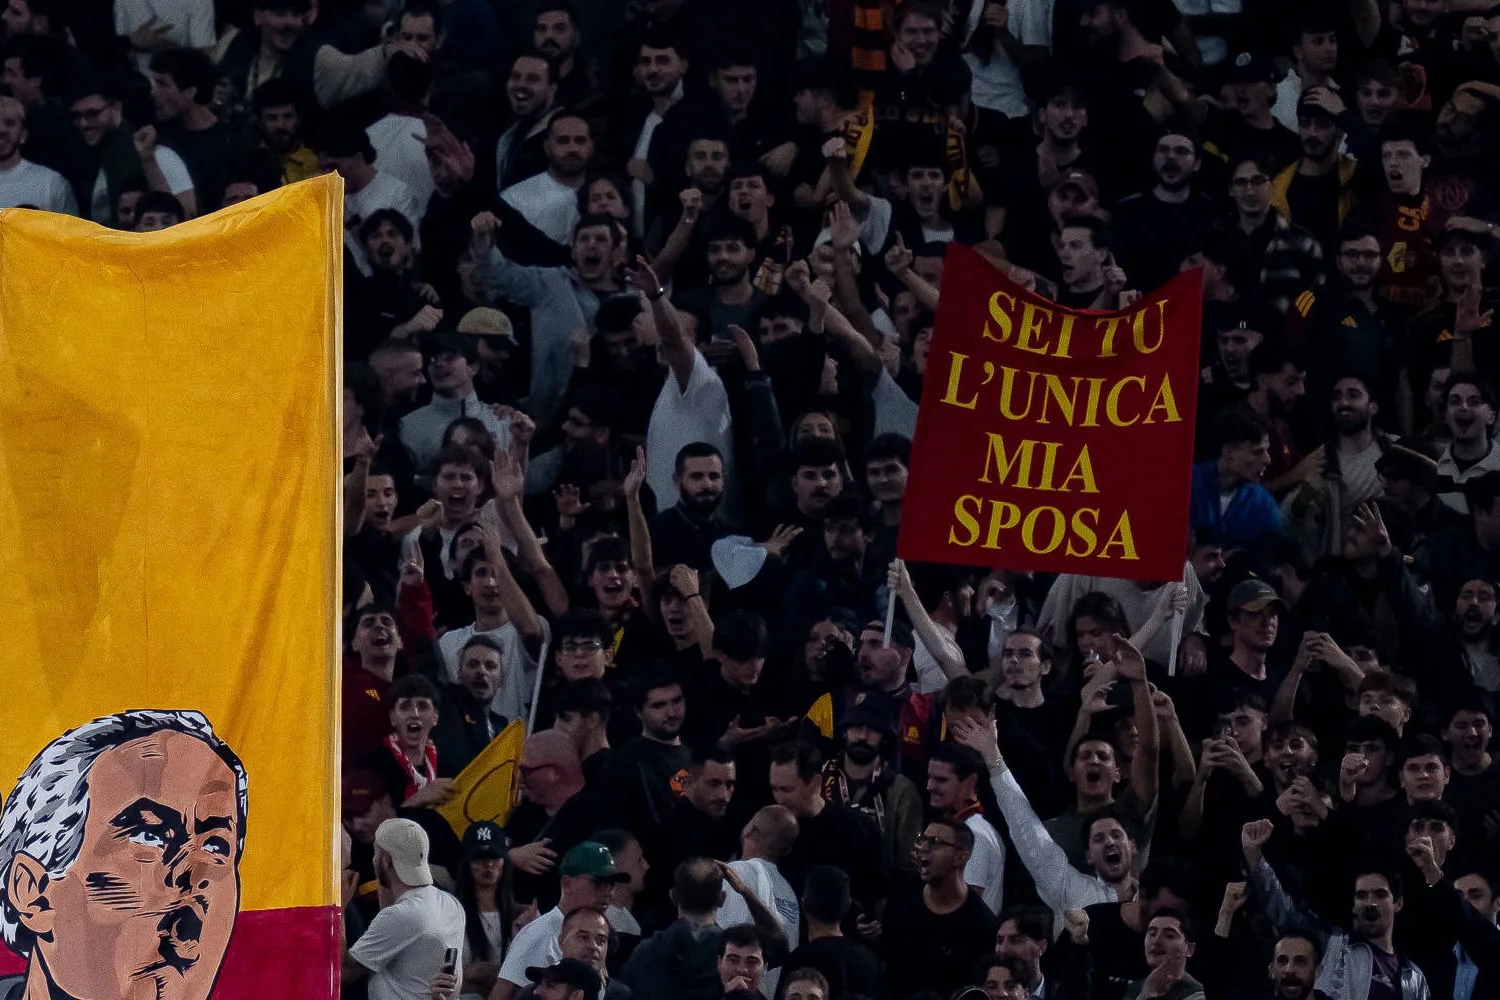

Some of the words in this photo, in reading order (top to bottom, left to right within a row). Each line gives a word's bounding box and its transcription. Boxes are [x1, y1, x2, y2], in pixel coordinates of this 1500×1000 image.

[983, 290, 1074, 358] SEI
[1096, 299, 1169, 357] TU
[940, 351, 1183, 428] L'UNICA
[978, 432, 1100, 494] MIA
[947, 494, 1141, 561] SPOSA
